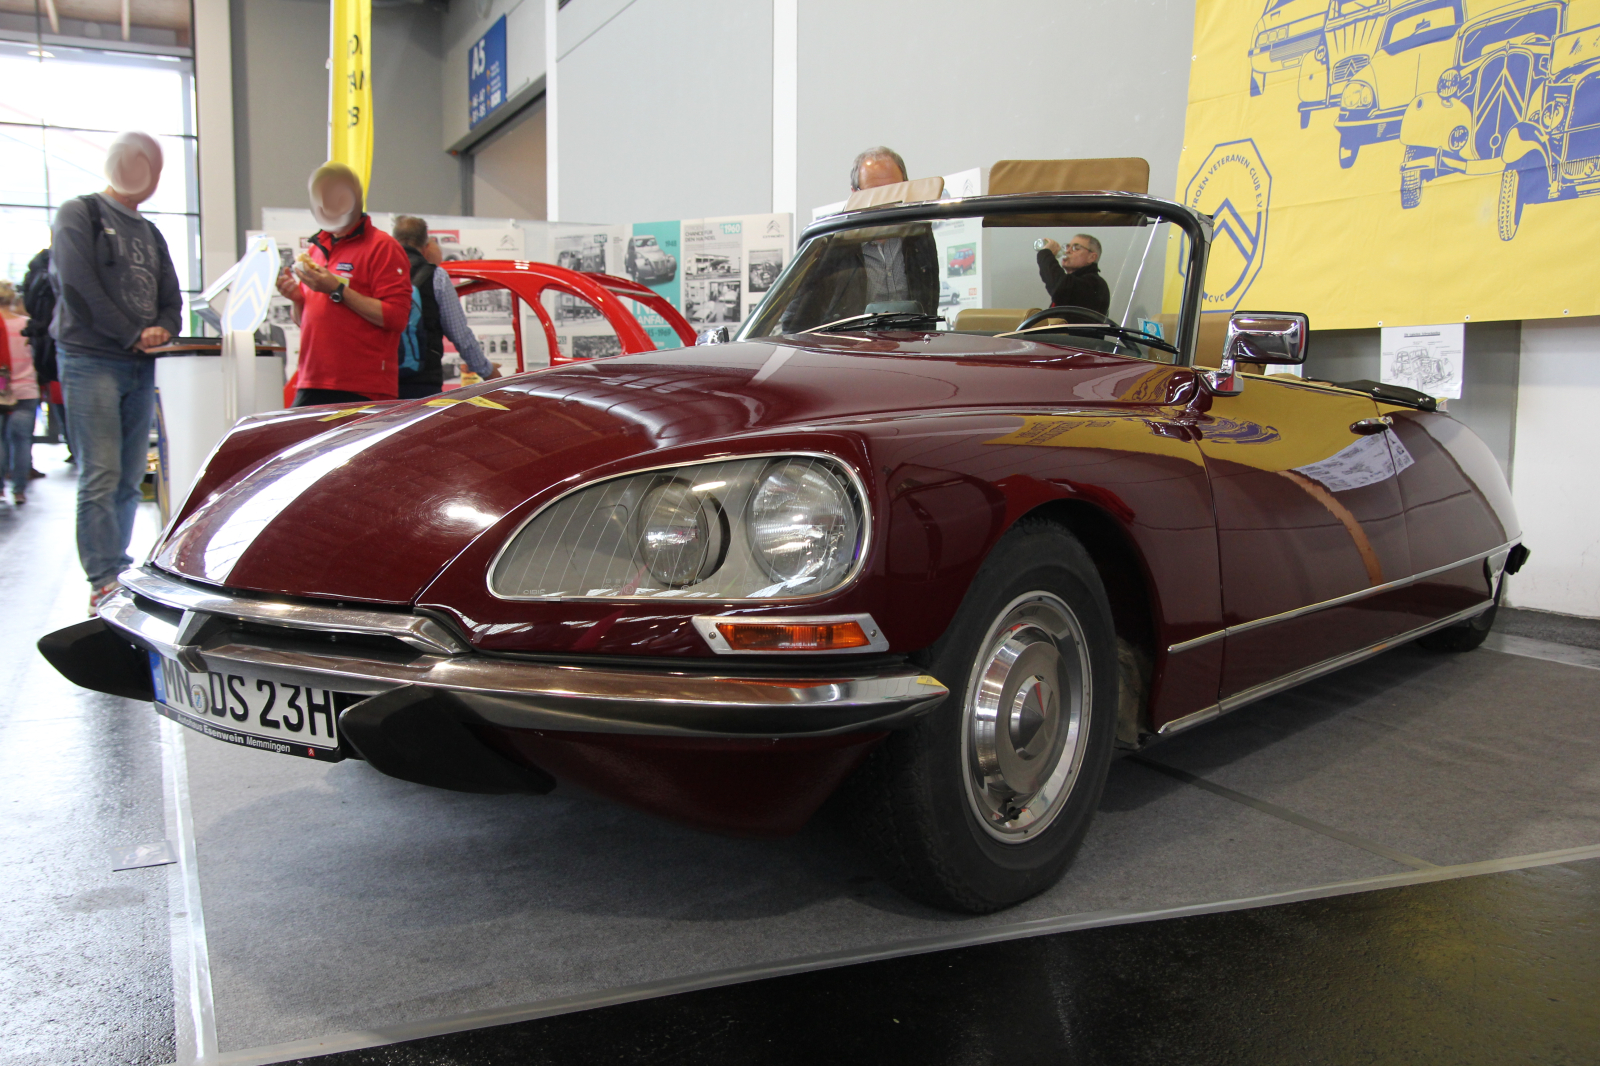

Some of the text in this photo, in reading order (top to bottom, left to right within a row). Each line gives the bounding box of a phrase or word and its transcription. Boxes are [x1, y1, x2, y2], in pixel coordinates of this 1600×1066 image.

[472, 39, 485, 80] A5
[1192, 176, 1209, 208] TROËN
[1208, 154, 1250, 175] VETERANEN
[1249, 167, 1261, 191] CLUB
[724, 223, 741, 234] 1960
[1208, 293, 1225, 303] CVC
[209, 671, 249, 722] DS
[256, 679, 334, 738] 23H
[177, 713, 291, 753] Autohaus Esenwein Memmingen
